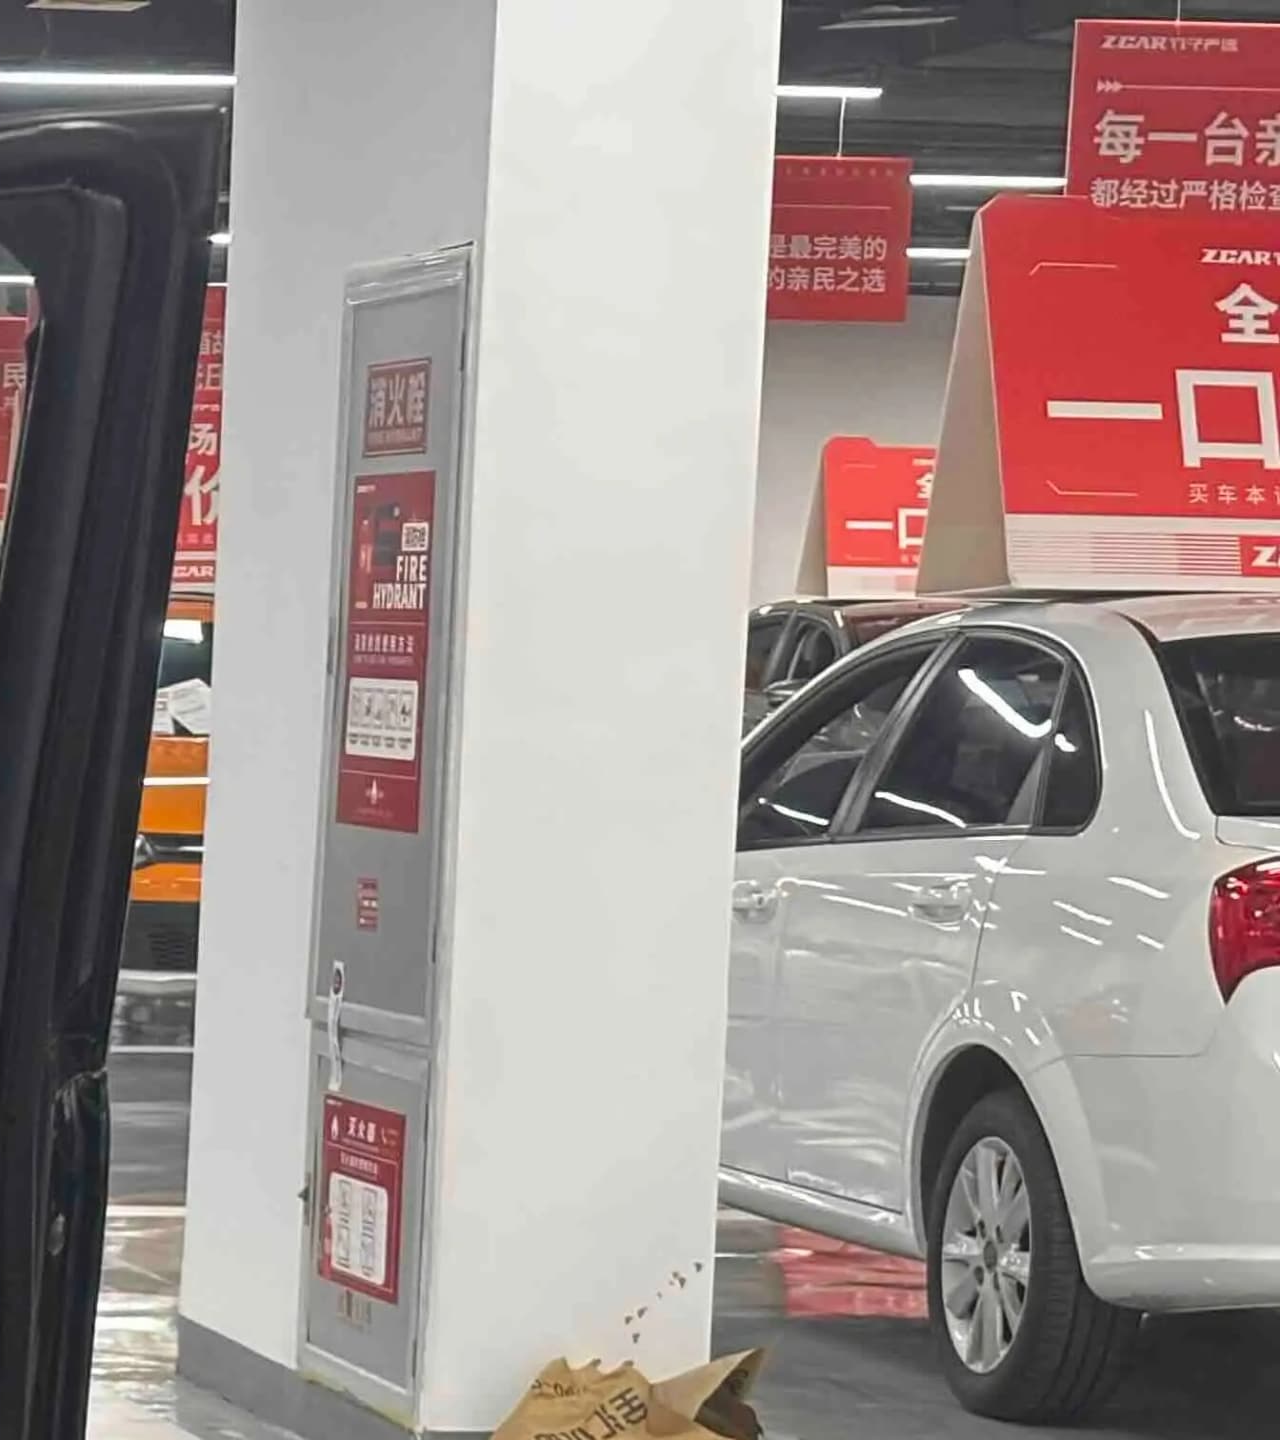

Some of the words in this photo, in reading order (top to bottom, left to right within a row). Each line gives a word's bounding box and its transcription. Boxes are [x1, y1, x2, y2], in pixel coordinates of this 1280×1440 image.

[1101, 34, 1166, 50] ZCAR
[1201, 248, 1271, 266] ZCAR
[396, 554, 428, 582] FIRE
[372, 582, 427, 610] HYDRANT
